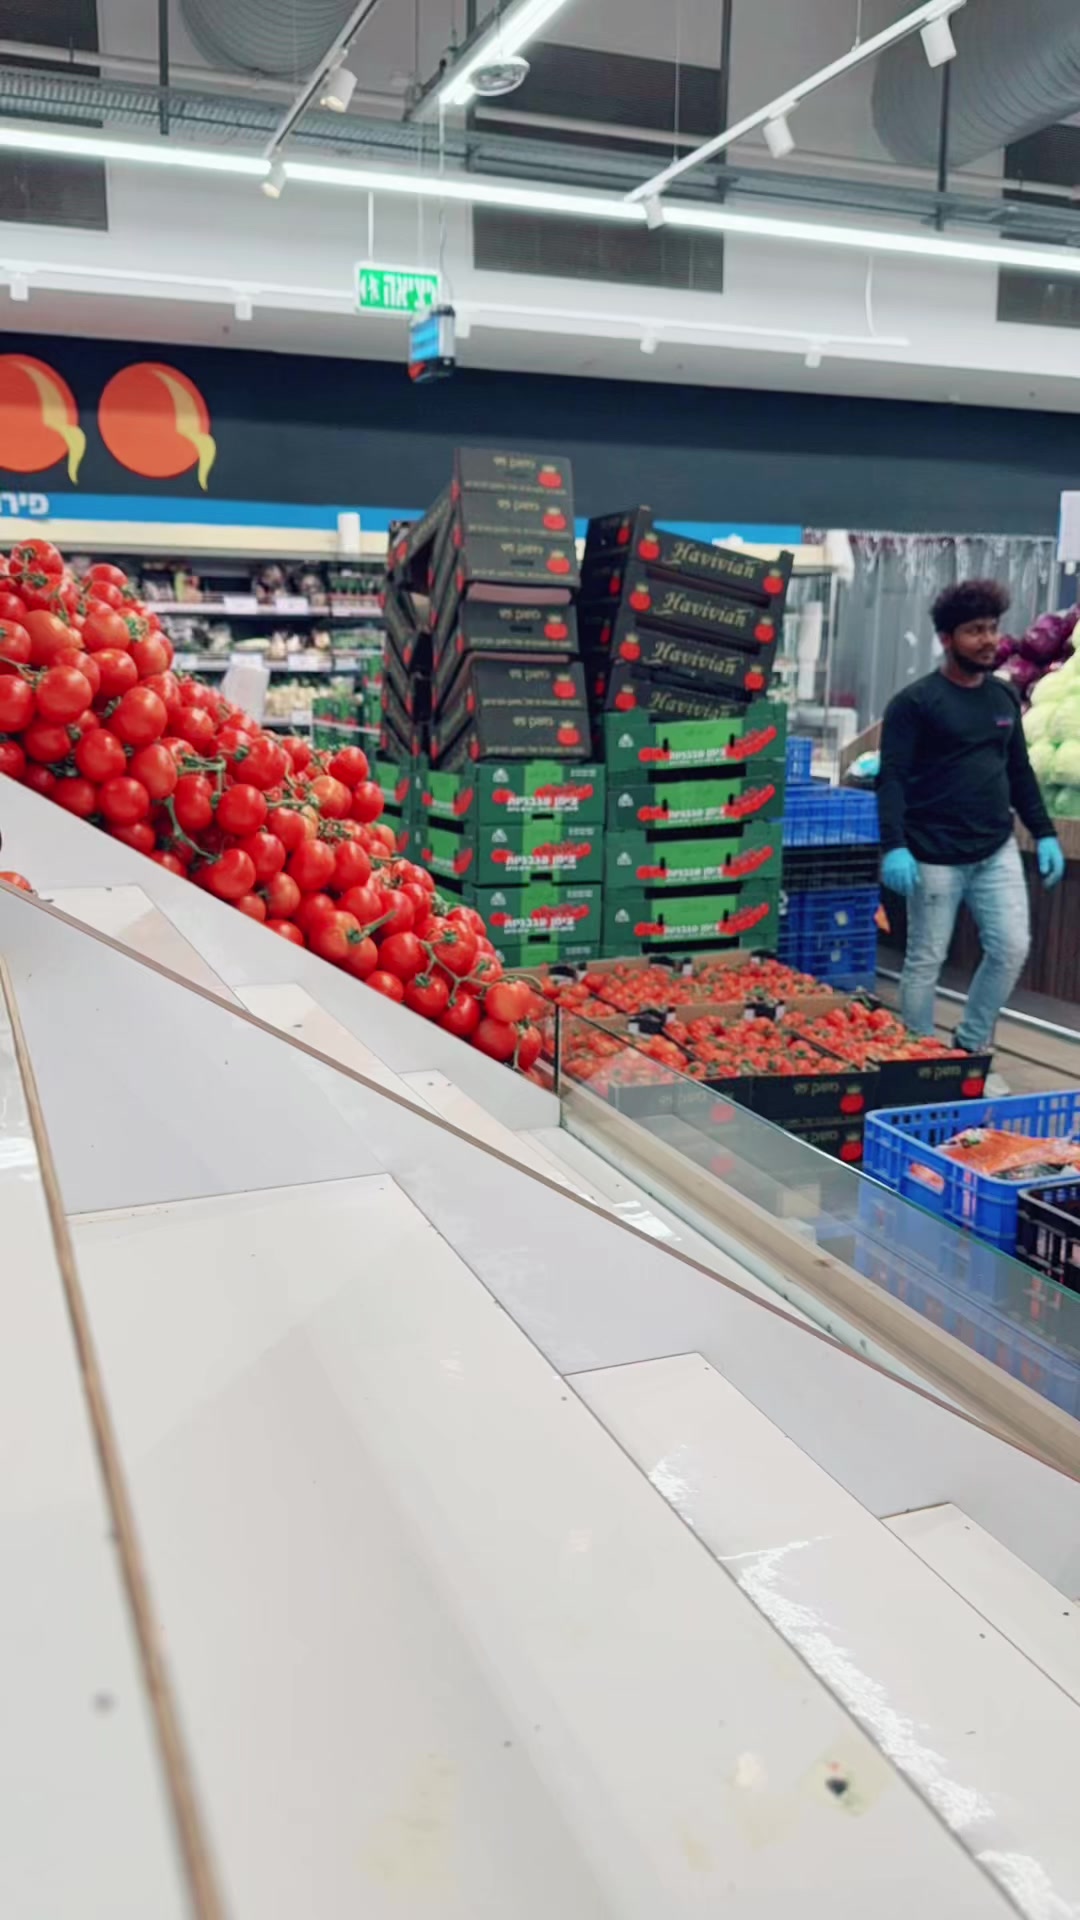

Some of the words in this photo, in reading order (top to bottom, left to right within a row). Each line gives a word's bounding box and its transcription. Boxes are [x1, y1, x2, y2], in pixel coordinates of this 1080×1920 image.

[0, 492, 49, 515] פיר
[664, 541, 758, 580] Havivian
[657, 591, 750, 627] Havivian
[648, 640, 741, 676] Havivian
